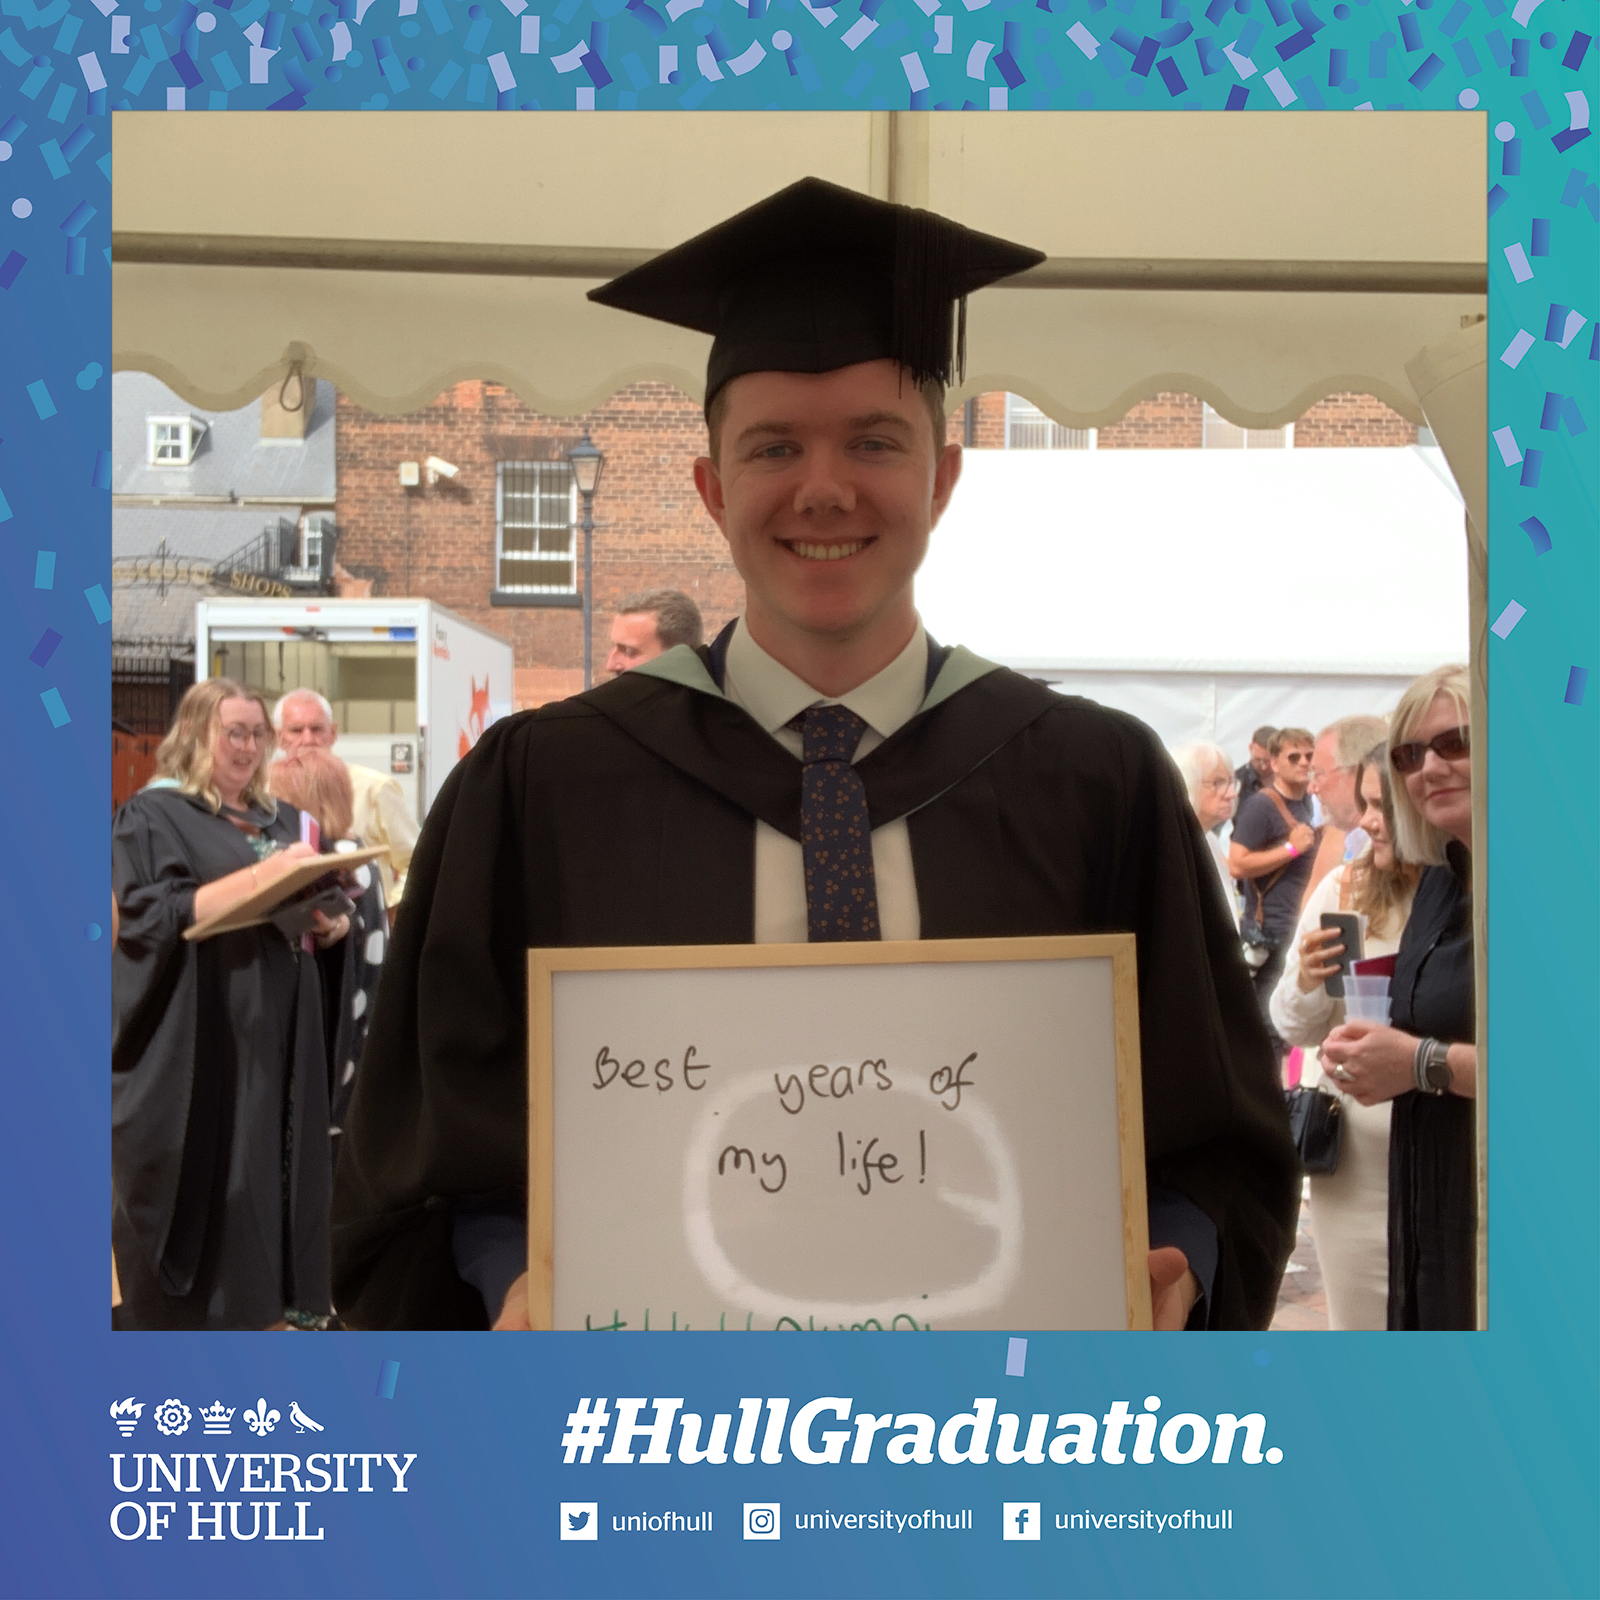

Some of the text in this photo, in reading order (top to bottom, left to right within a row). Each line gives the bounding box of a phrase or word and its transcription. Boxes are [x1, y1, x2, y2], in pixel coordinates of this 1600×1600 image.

[231, 571, 292, 598] SHOPS
[593, 1046, 978, 1114] Best years of
[718, 1130, 927, 1196] my life!
